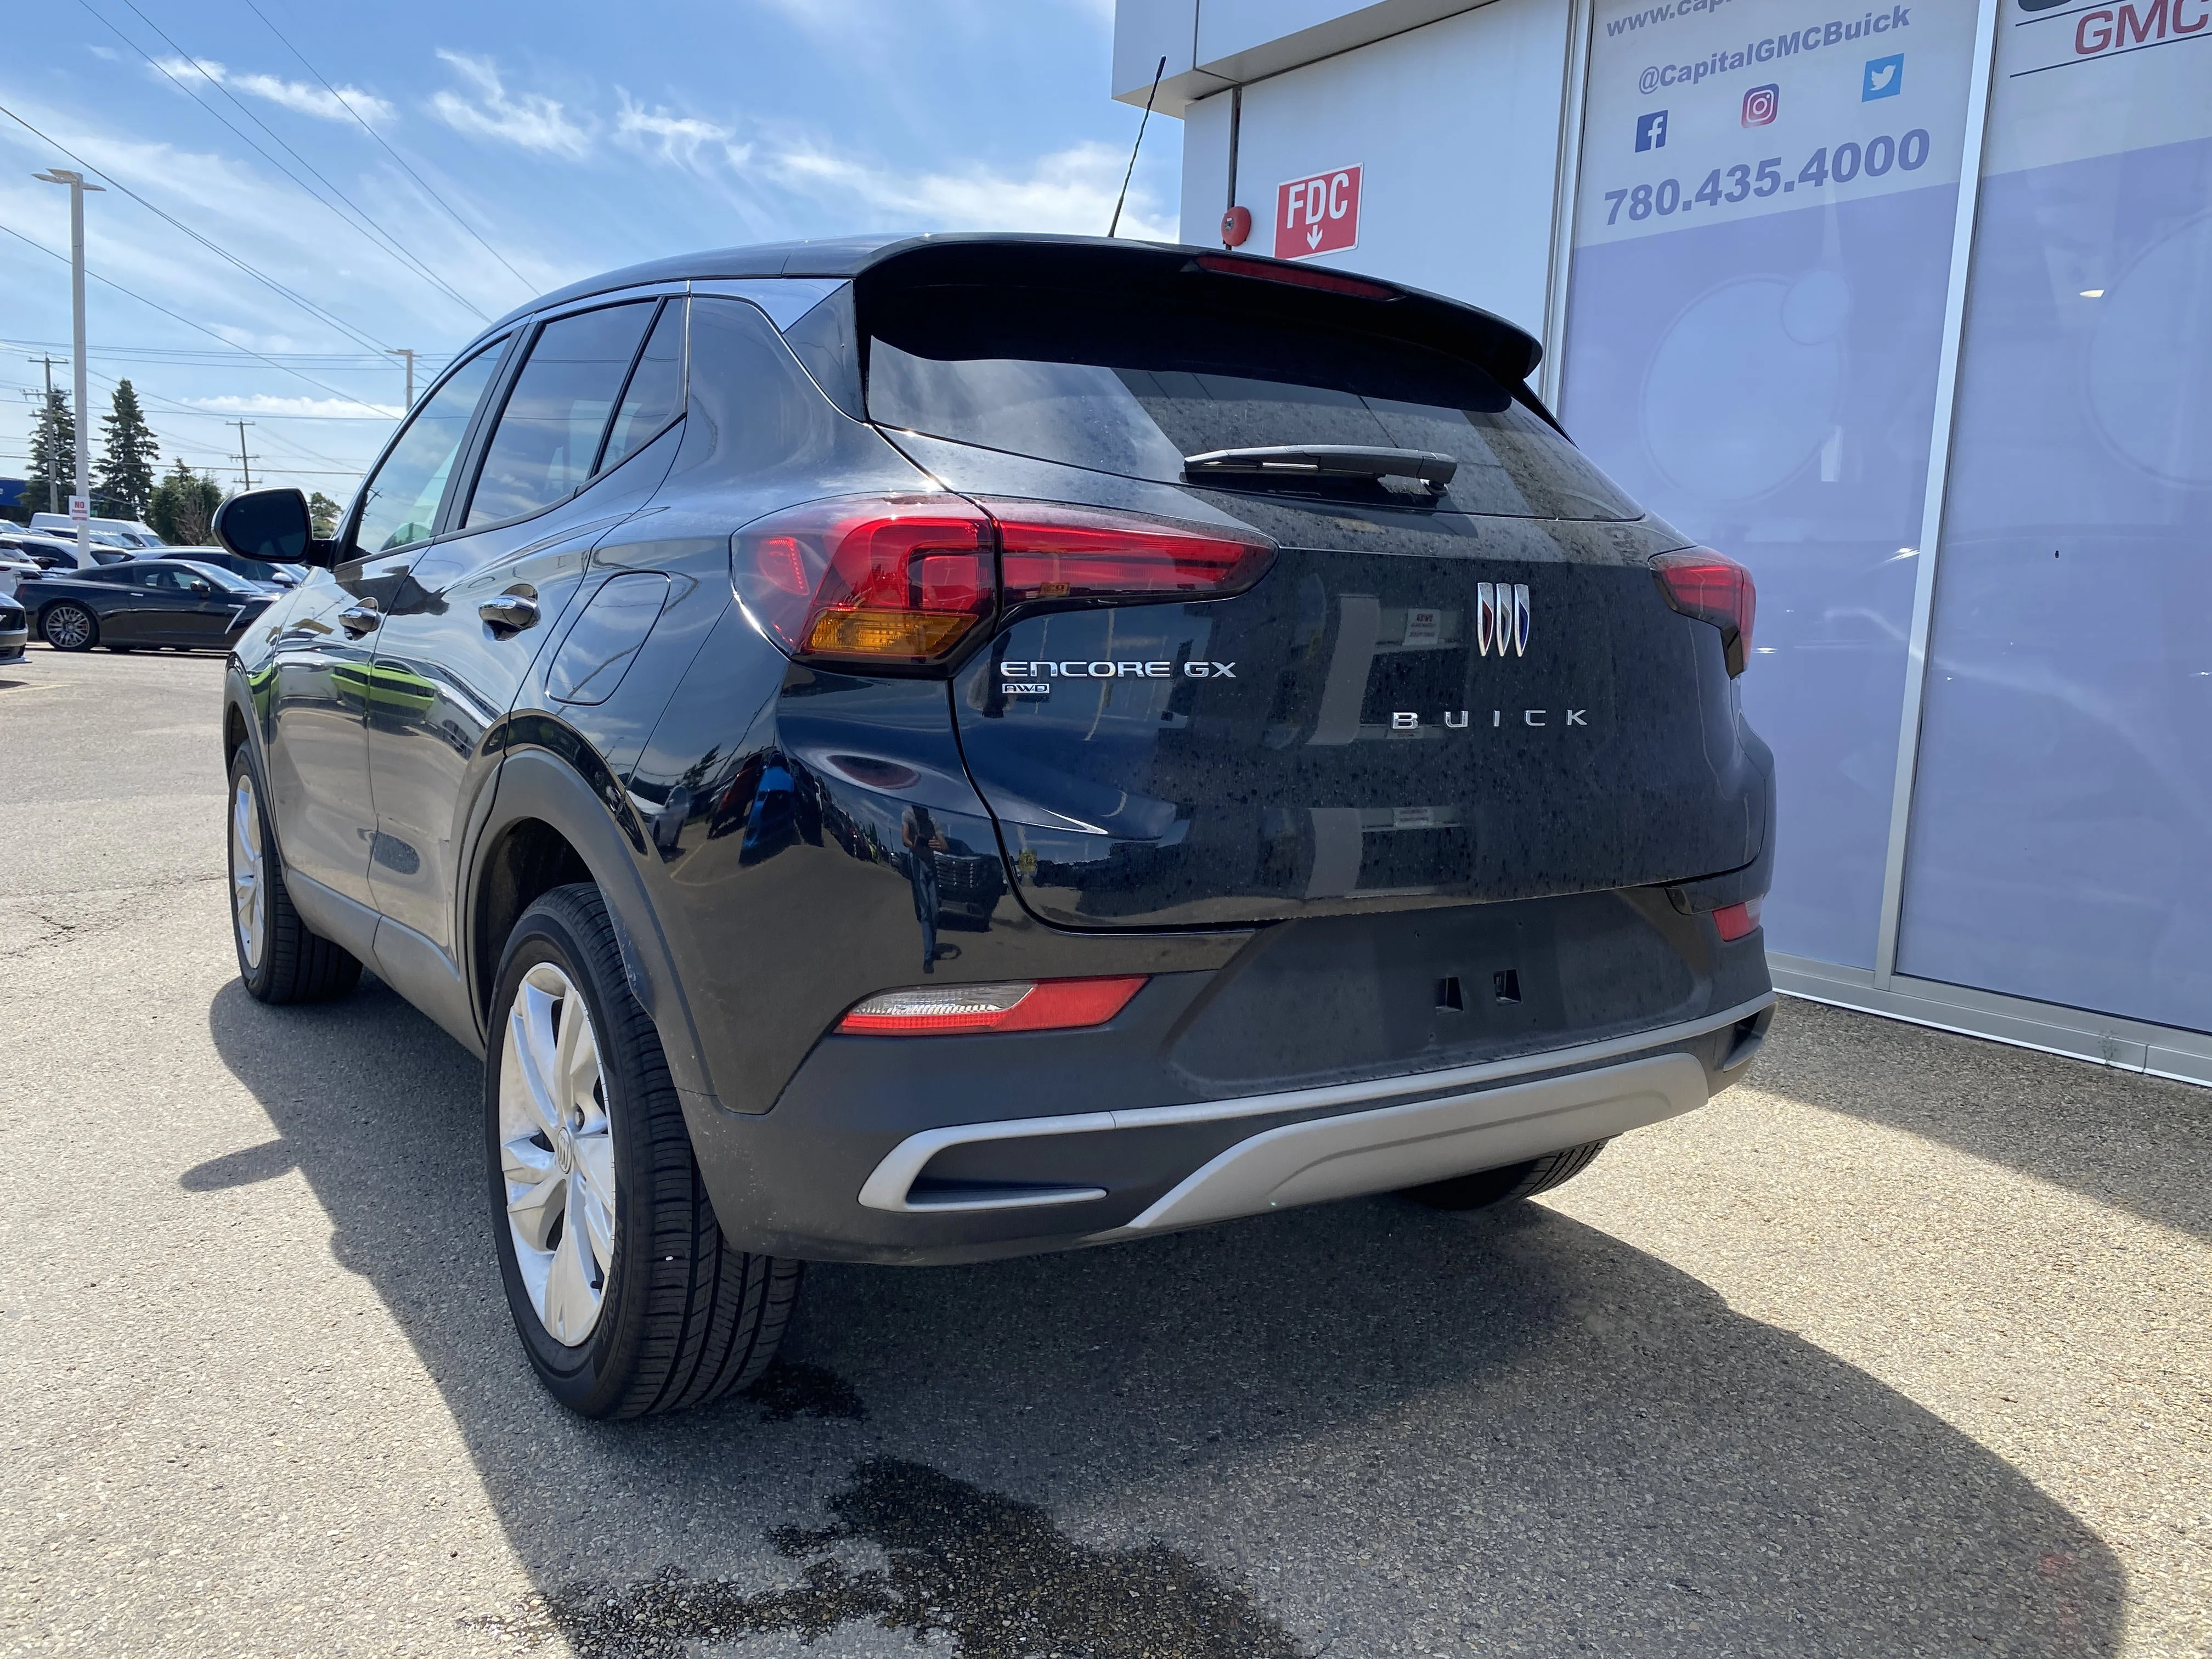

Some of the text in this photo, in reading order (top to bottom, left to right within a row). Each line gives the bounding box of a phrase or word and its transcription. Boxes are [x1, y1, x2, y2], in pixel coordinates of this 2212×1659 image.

[1638, 5, 1911, 94] @CapitalGMCBuick
[1287, 173, 1349, 229] FDC
[1604, 128, 1930, 225] 780.435.4000
[1000, 661, 1237, 678] ENCORE GX
[1392, 709, 1588, 729] BUICK
